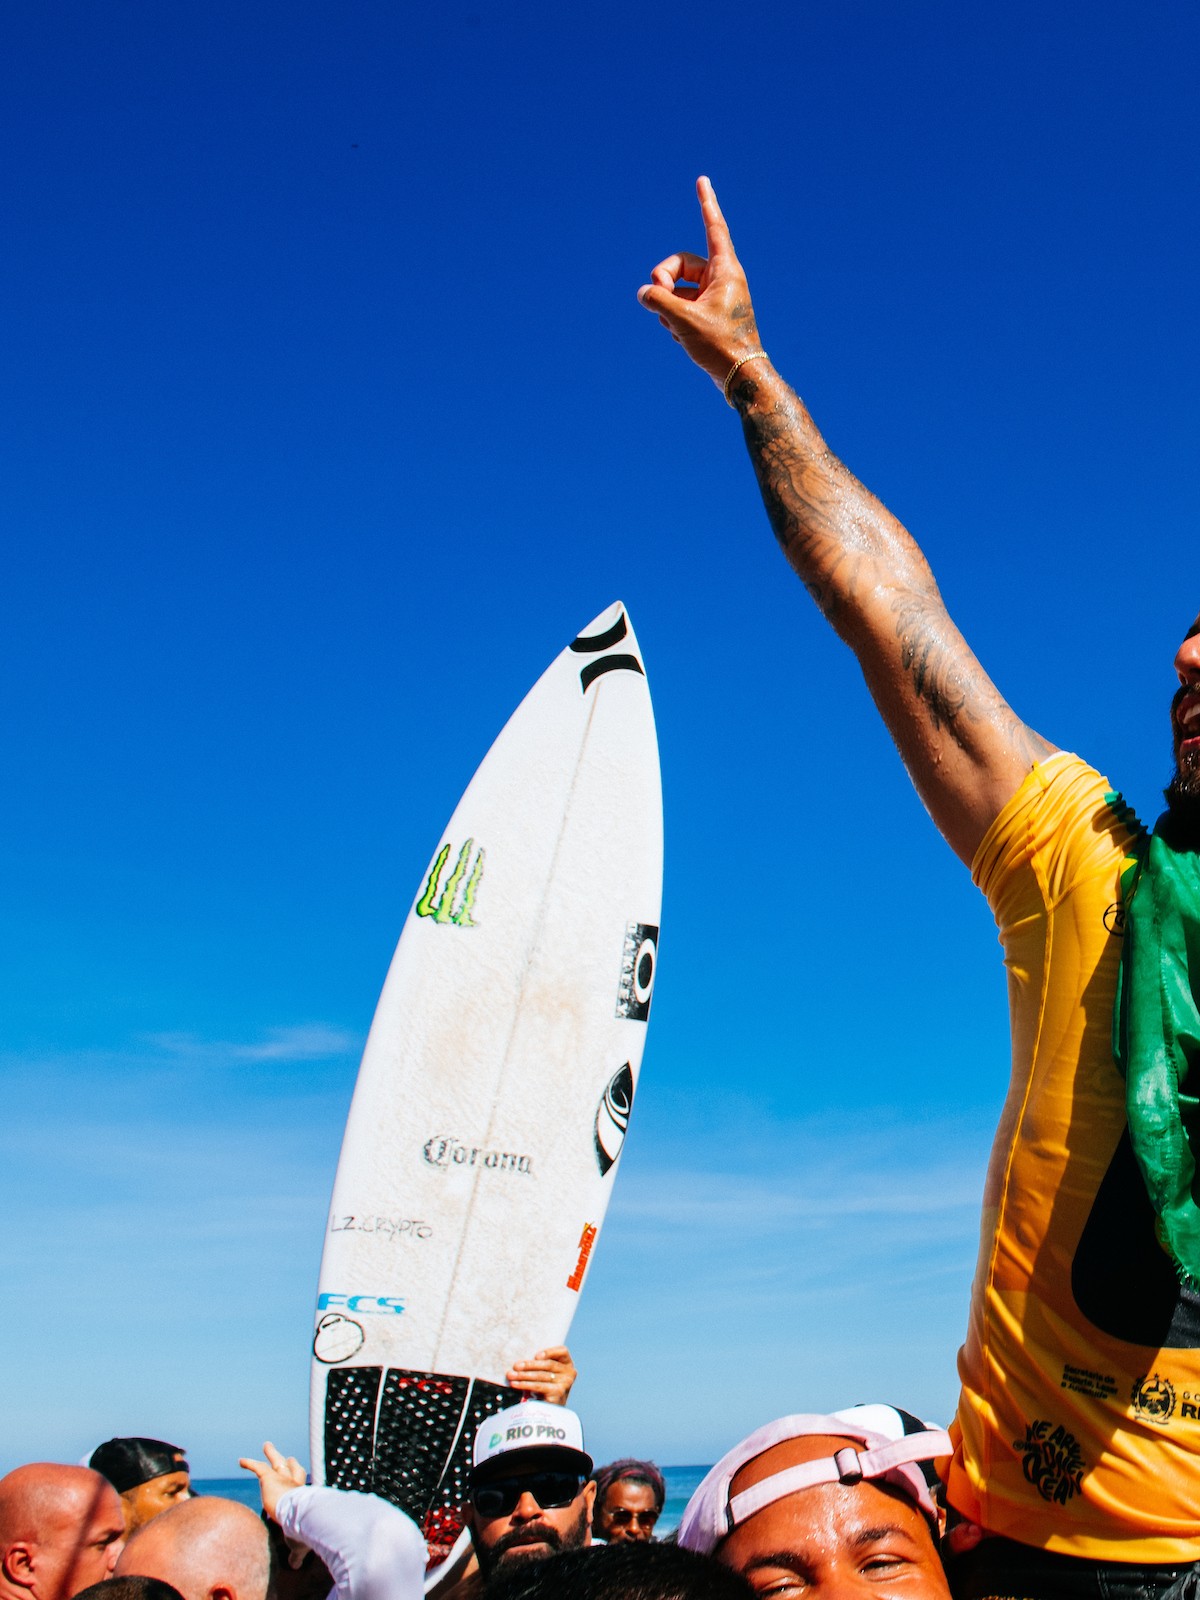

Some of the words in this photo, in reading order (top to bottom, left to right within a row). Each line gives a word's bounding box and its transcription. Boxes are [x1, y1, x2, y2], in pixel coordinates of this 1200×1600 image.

[423, 1134, 534, 1175] Corona
[317, 1292, 406, 1314] FCS
[506, 1425, 534, 1442] RIO
[536, 1424, 566, 1441] PRO
[1022, 1452, 1084, 1505] OCEAN
